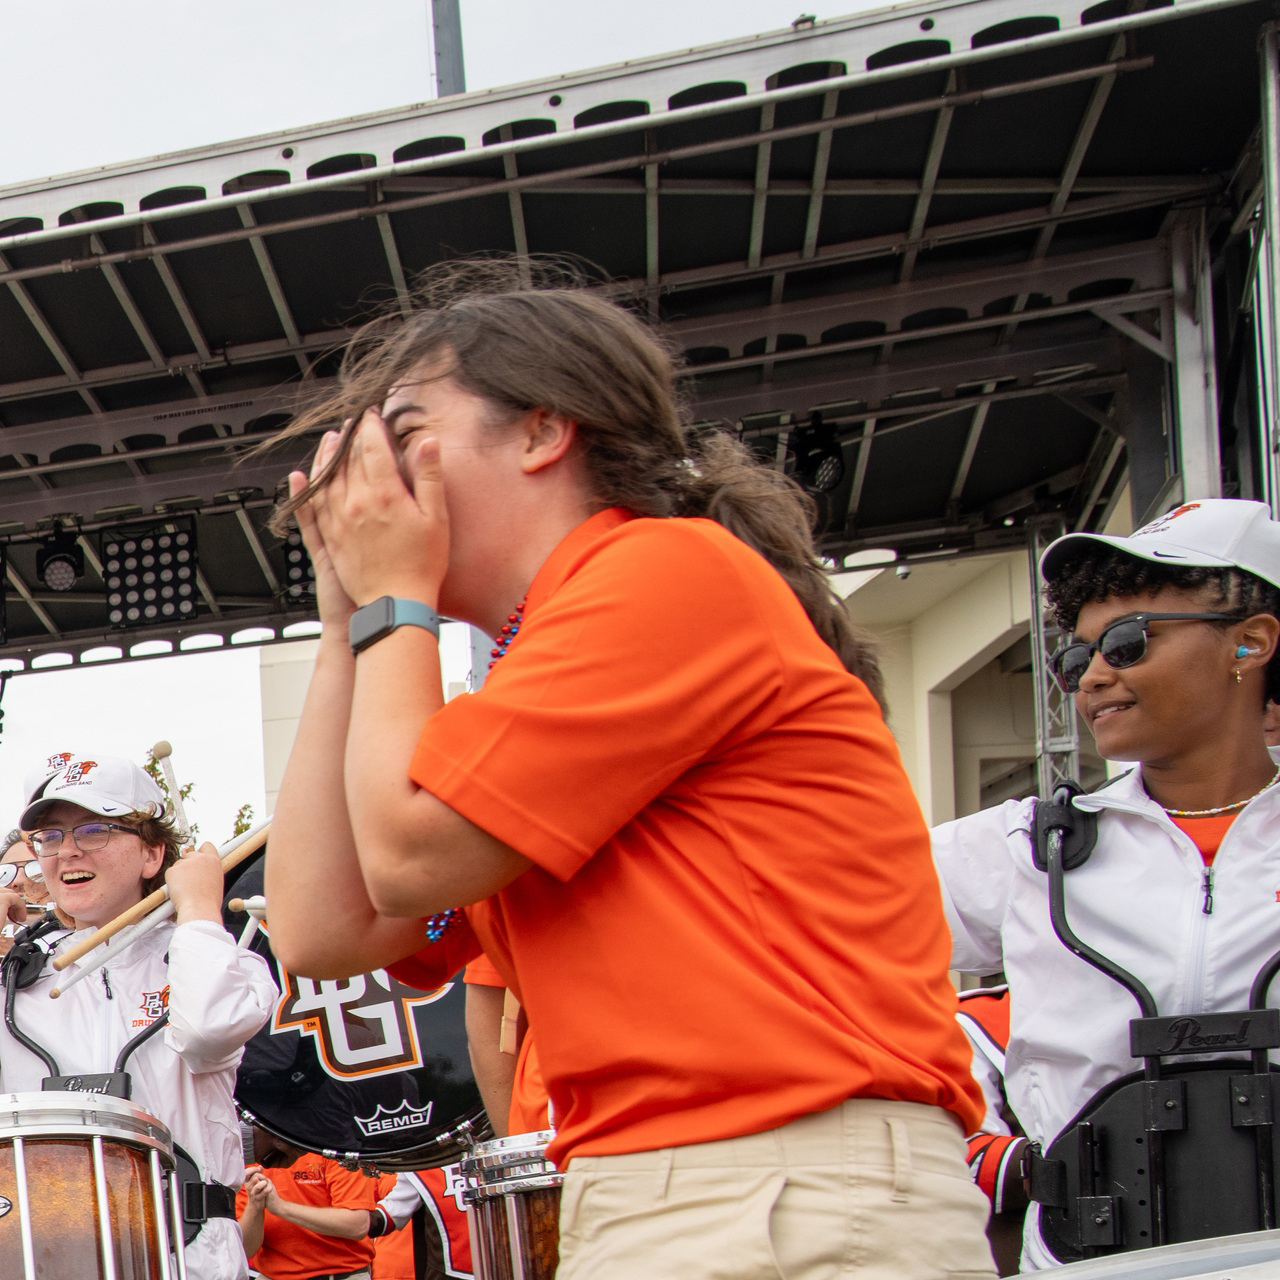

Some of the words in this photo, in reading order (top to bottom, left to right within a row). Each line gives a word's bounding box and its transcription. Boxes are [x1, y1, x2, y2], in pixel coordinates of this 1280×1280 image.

[182, 408, 196, 416] LOAD
[197, 406, 217, 414] EVENLY
[218, 401, 253, 411] DISTRIBUTED
[1157, 1017, 1252, 1052] Pearl
[367, 1112, 424, 1132] REMO
